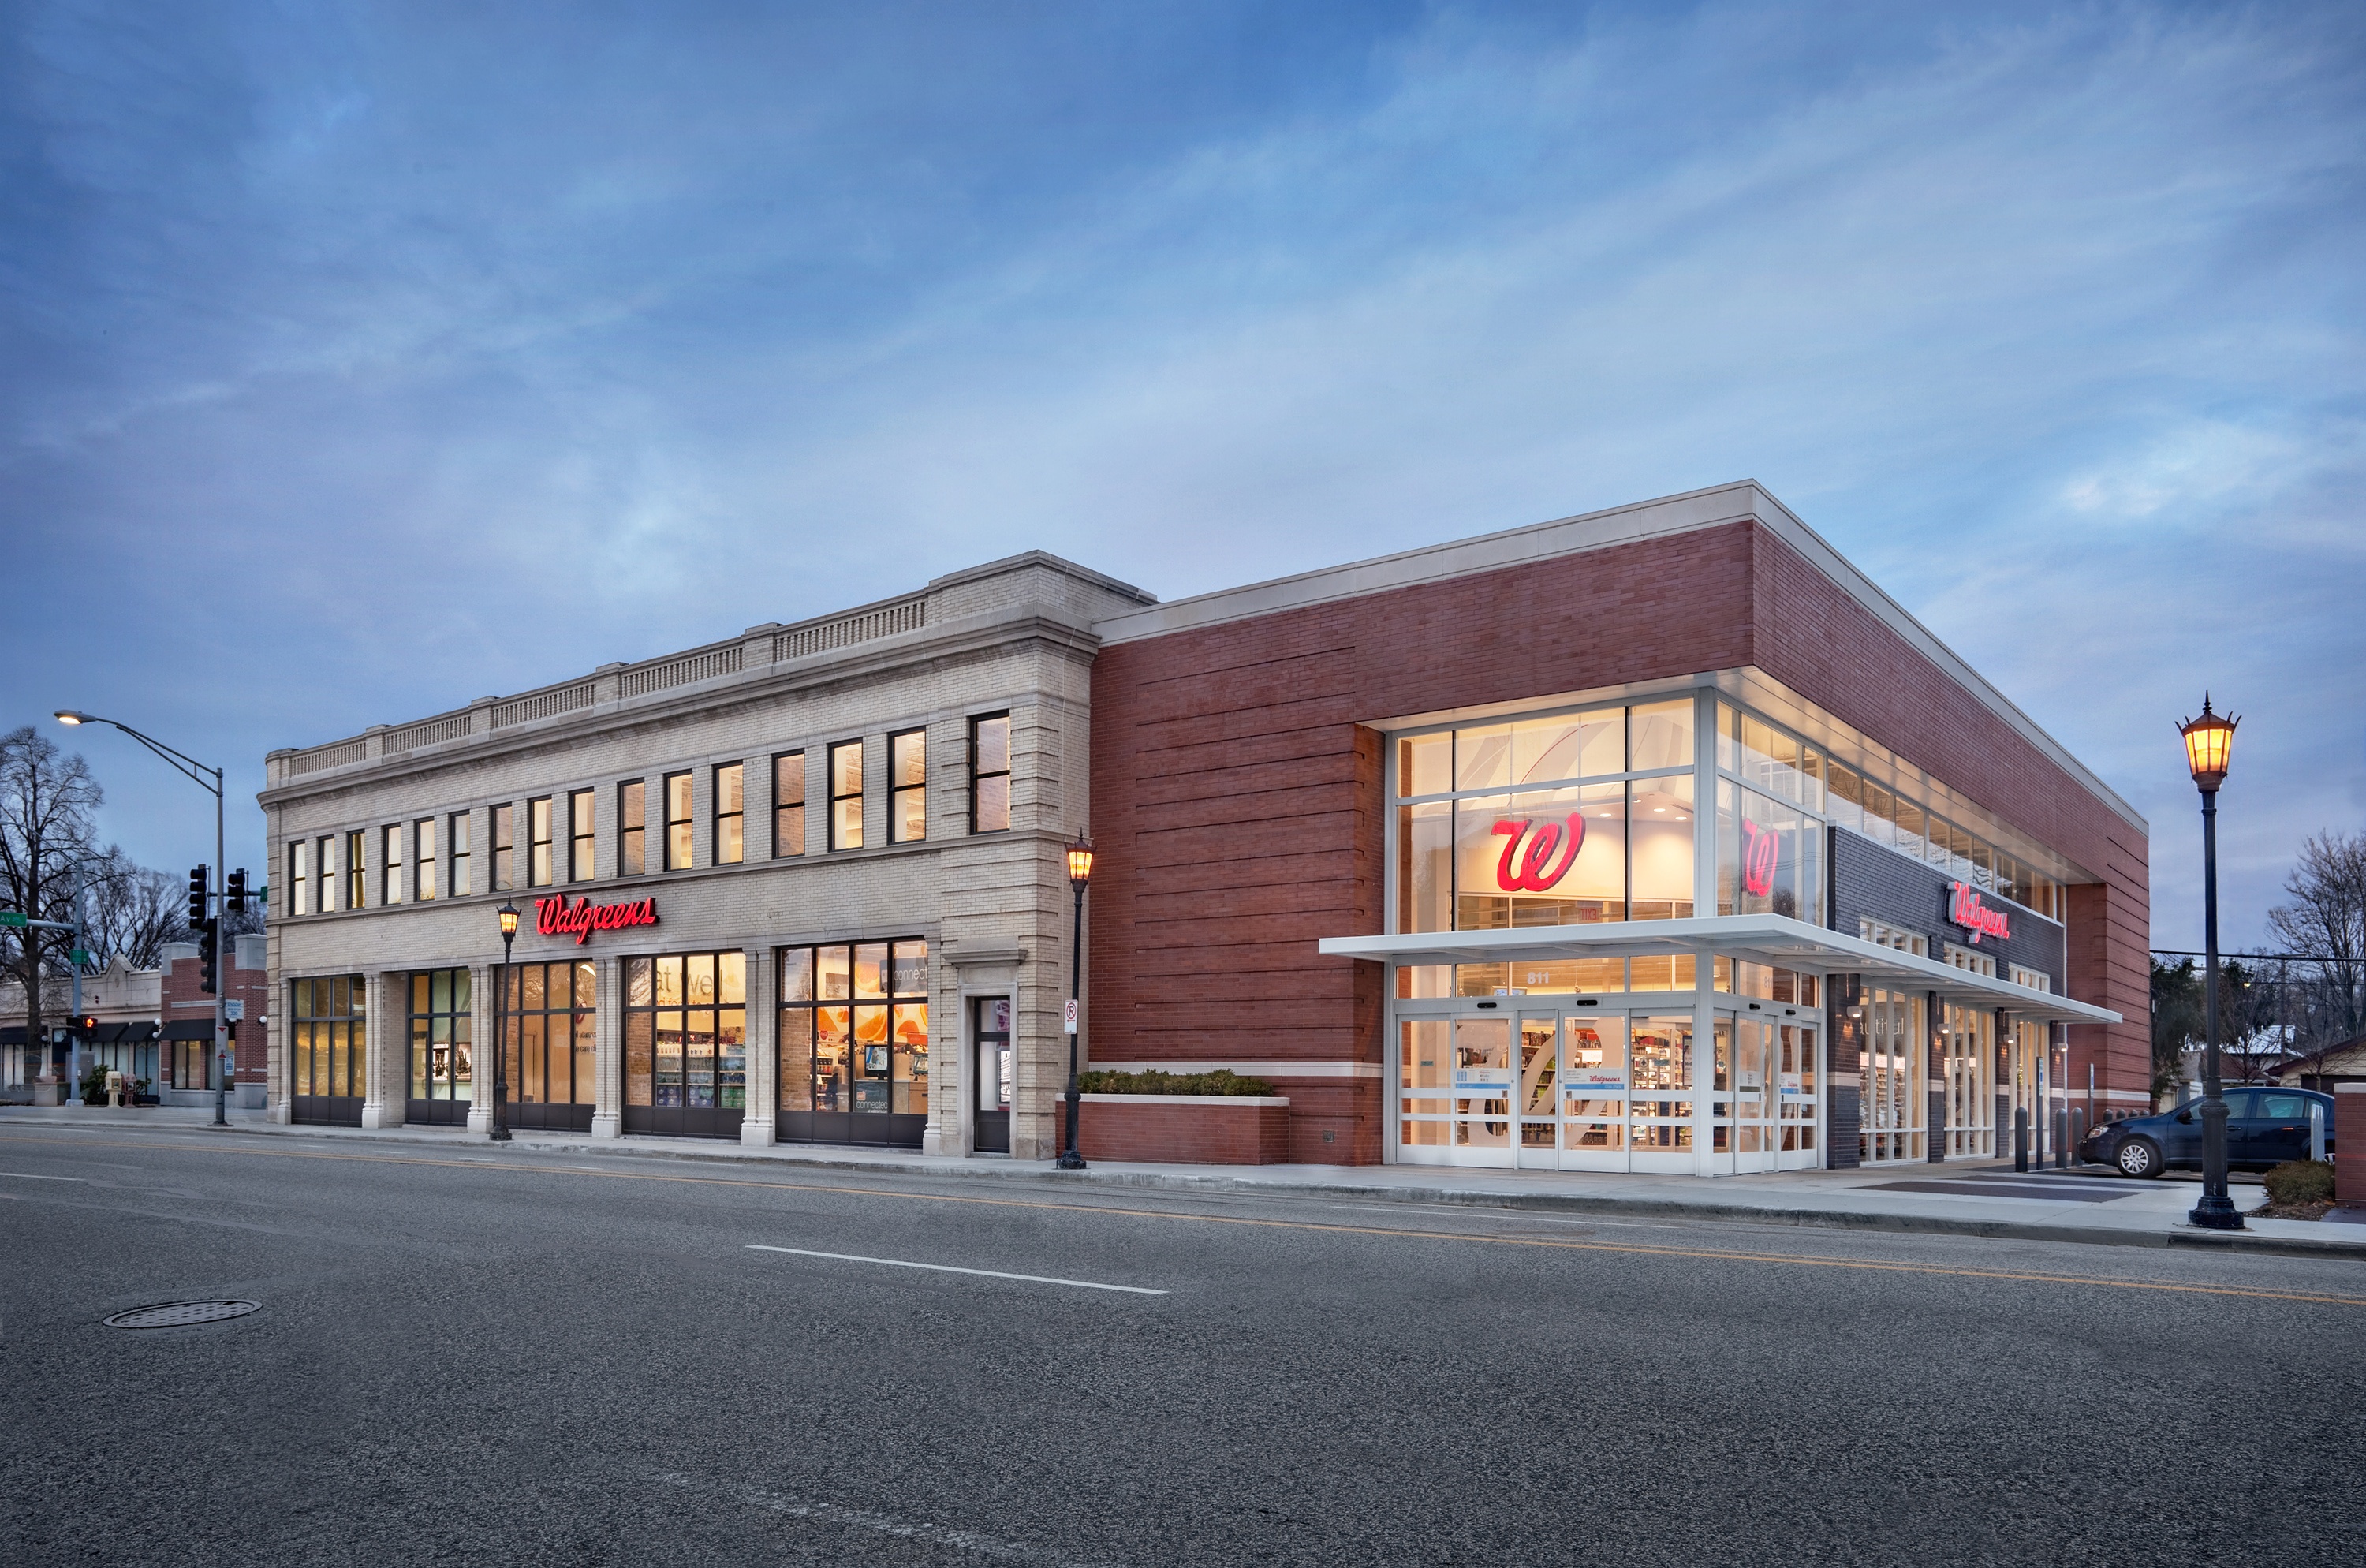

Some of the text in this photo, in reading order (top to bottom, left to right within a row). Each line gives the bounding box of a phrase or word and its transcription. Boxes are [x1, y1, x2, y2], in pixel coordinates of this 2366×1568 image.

[1491, 812, 1586, 892] W
[535, 894, 658, 945] Walgreens
[1951, 880, 2010, 943] Walgreens
[1527, 971, 1549, 984] 811
[1589, 1075, 1621, 1084] Walgreens
